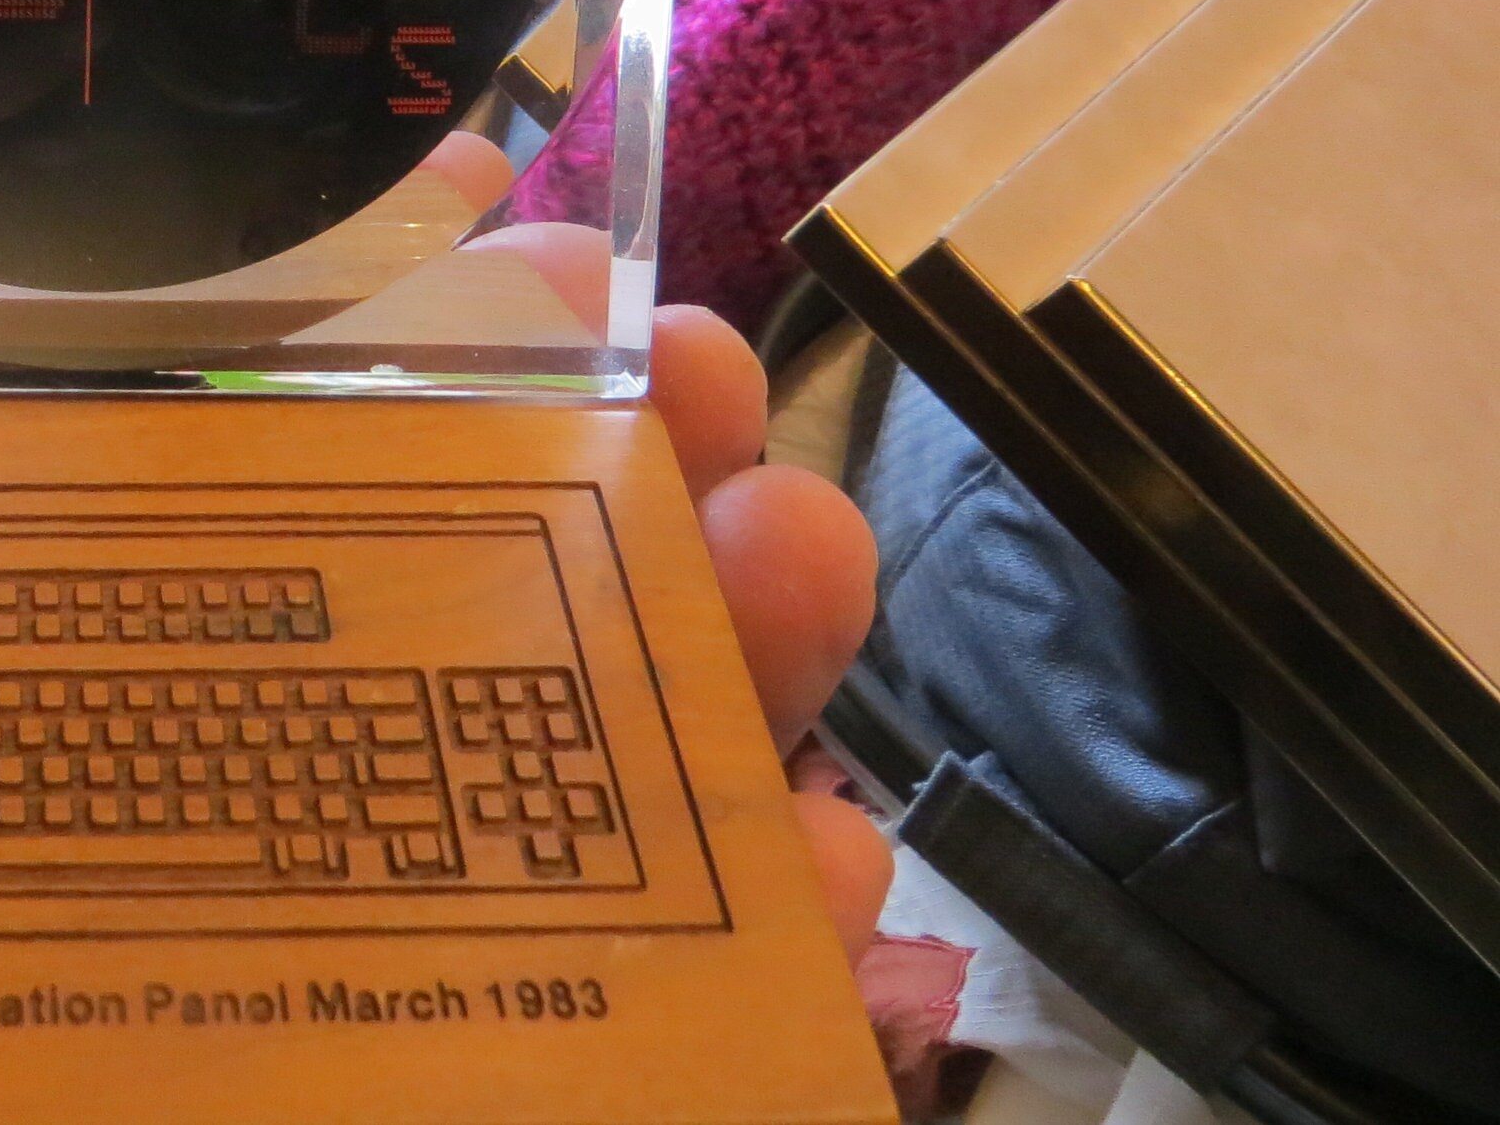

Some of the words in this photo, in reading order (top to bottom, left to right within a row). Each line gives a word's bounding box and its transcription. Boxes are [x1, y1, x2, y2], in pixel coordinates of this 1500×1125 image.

[142, 980, 291, 1025] Panel
[305, 978, 470, 1024] March
[484, 977, 609, 1021] 1983
